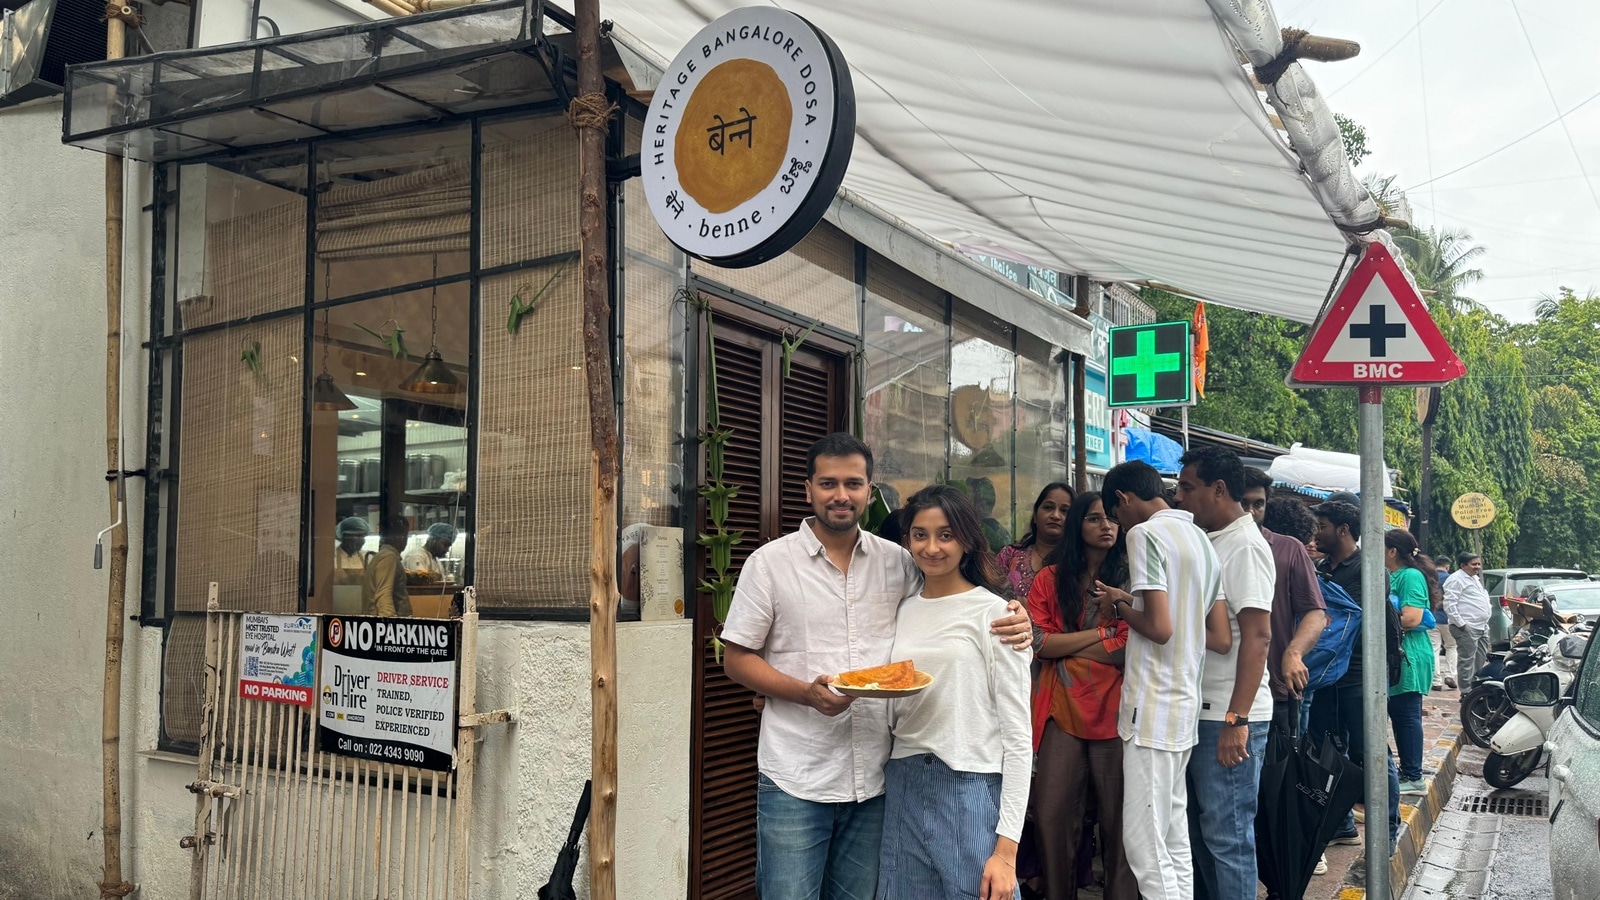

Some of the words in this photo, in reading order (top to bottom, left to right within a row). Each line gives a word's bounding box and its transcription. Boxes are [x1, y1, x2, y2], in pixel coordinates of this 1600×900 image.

[654, 59, 697, 166] HERITAGE
[702, 25, 804, 62] BANGALORE
[799, 64, 818, 127] DOSA
[698, 209, 763, 239] benne
[1353, 363, 1403, 379] BMC
[245, 632, 254, 640] EYE
[254, 632, 277, 641] HOSPITAL
[259, 624, 280, 633] TRUSTED
[344, 621, 373, 651] NO
[375, 622, 449, 648] PARKING
[383, 645, 404, 655] FRONT
[407, 647, 415, 655] OF
[416, 647, 429, 655] THE
[430, 648, 448, 657] GATE
[334, 664, 371, 690] Driver
[377, 671, 408, 685] DRIVER
[409, 676, 449, 689] SERVICE
[244, 684, 260, 696] NO
[261, 686, 308, 702] PARKING
[341, 688, 368, 710] Hire
[376, 688, 413, 703] TRAINED,
[375, 704, 403, 717] POLICE
[405, 709, 445, 721] VERIFIED
[375, 720, 430, 737] EXPERIENCED
[338, 738, 352, 751] Call
[353, 743, 363, 753] on
[369, 743, 382, 756] 022
[384, 745, 402, 760] 4343
[404, 750, 424, 763] 9090
